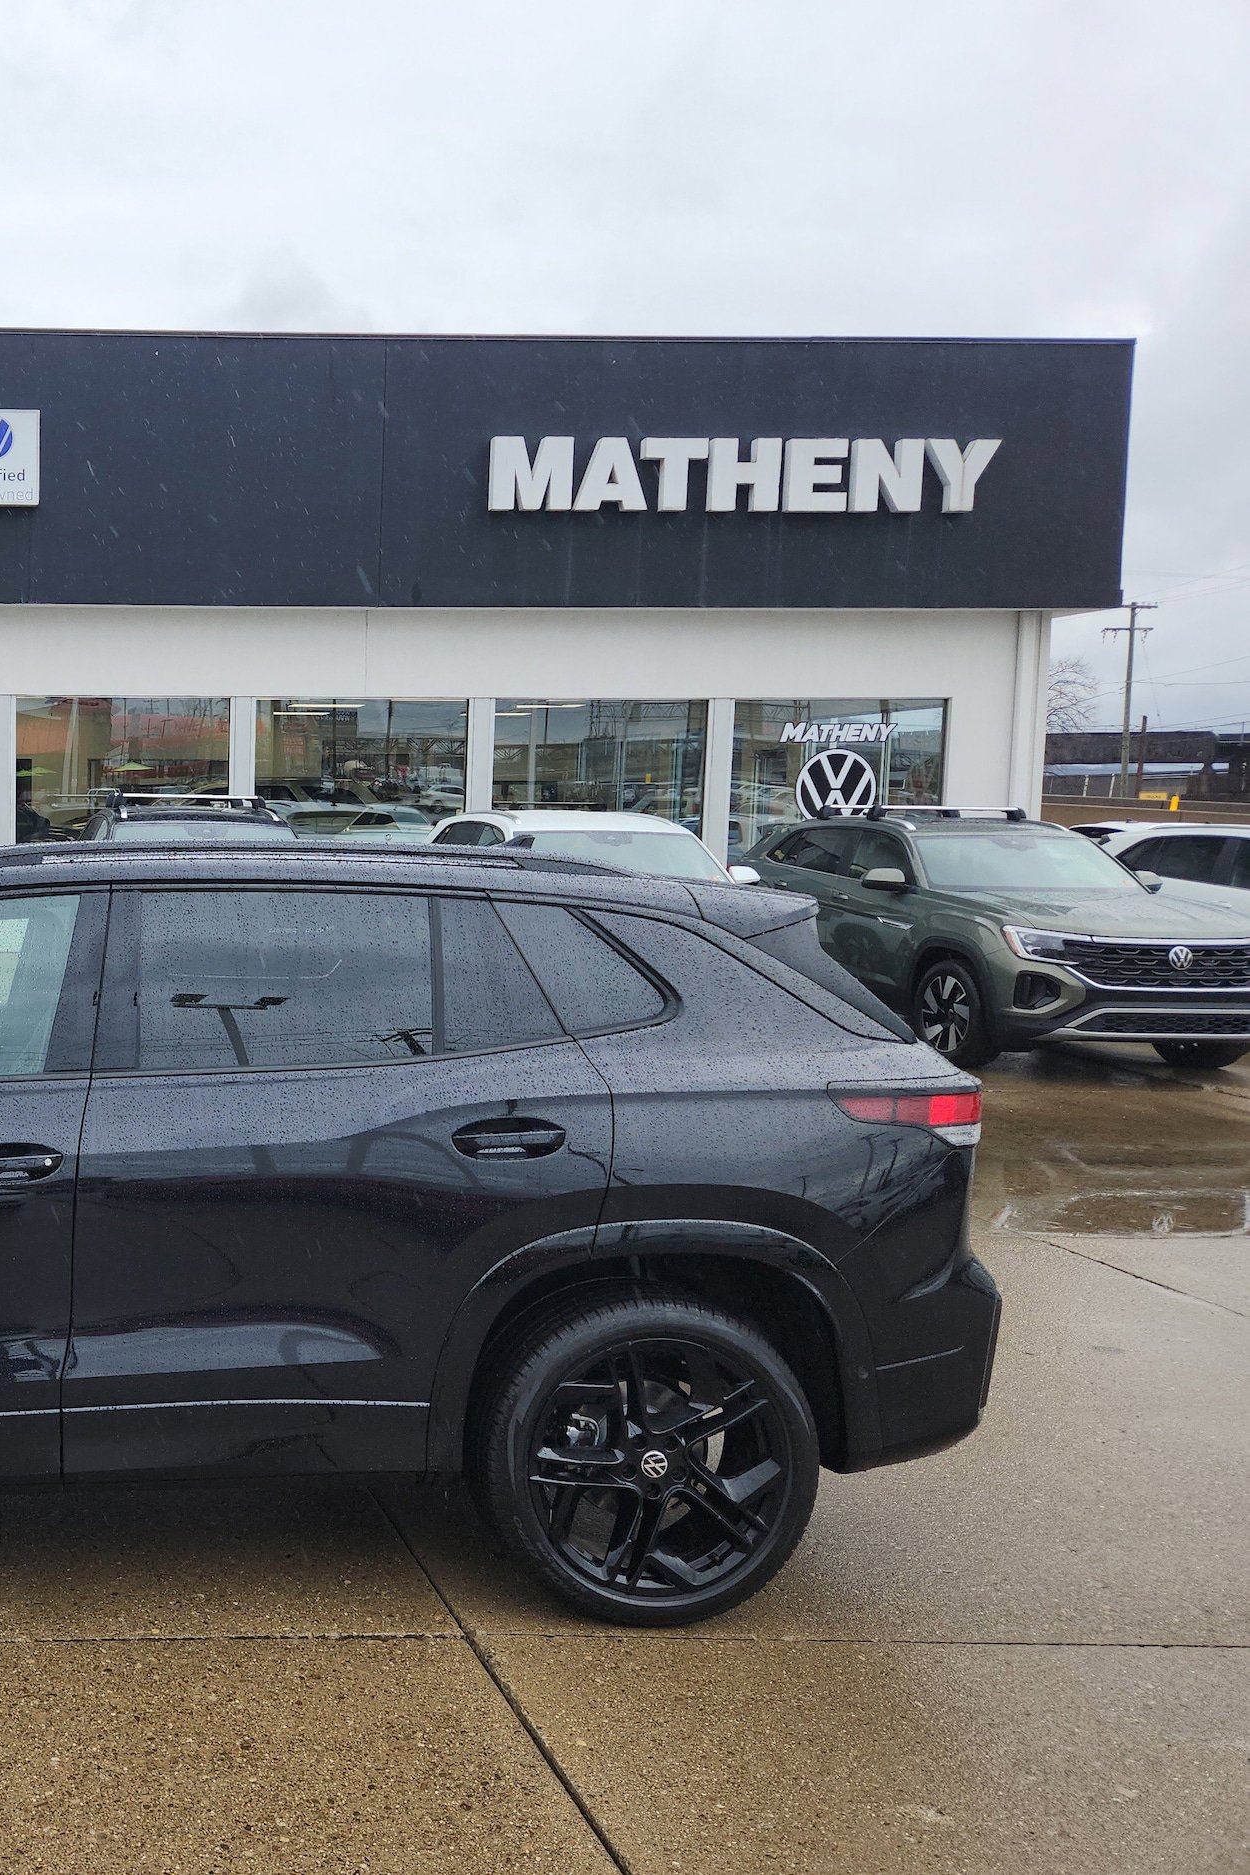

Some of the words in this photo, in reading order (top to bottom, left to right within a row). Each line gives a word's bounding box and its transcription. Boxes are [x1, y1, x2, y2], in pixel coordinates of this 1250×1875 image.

[487, 435, 1002, 514] MATHENY
[779, 721, 898, 743] MATHENY
[1169, 946, 1193, 970] VW
